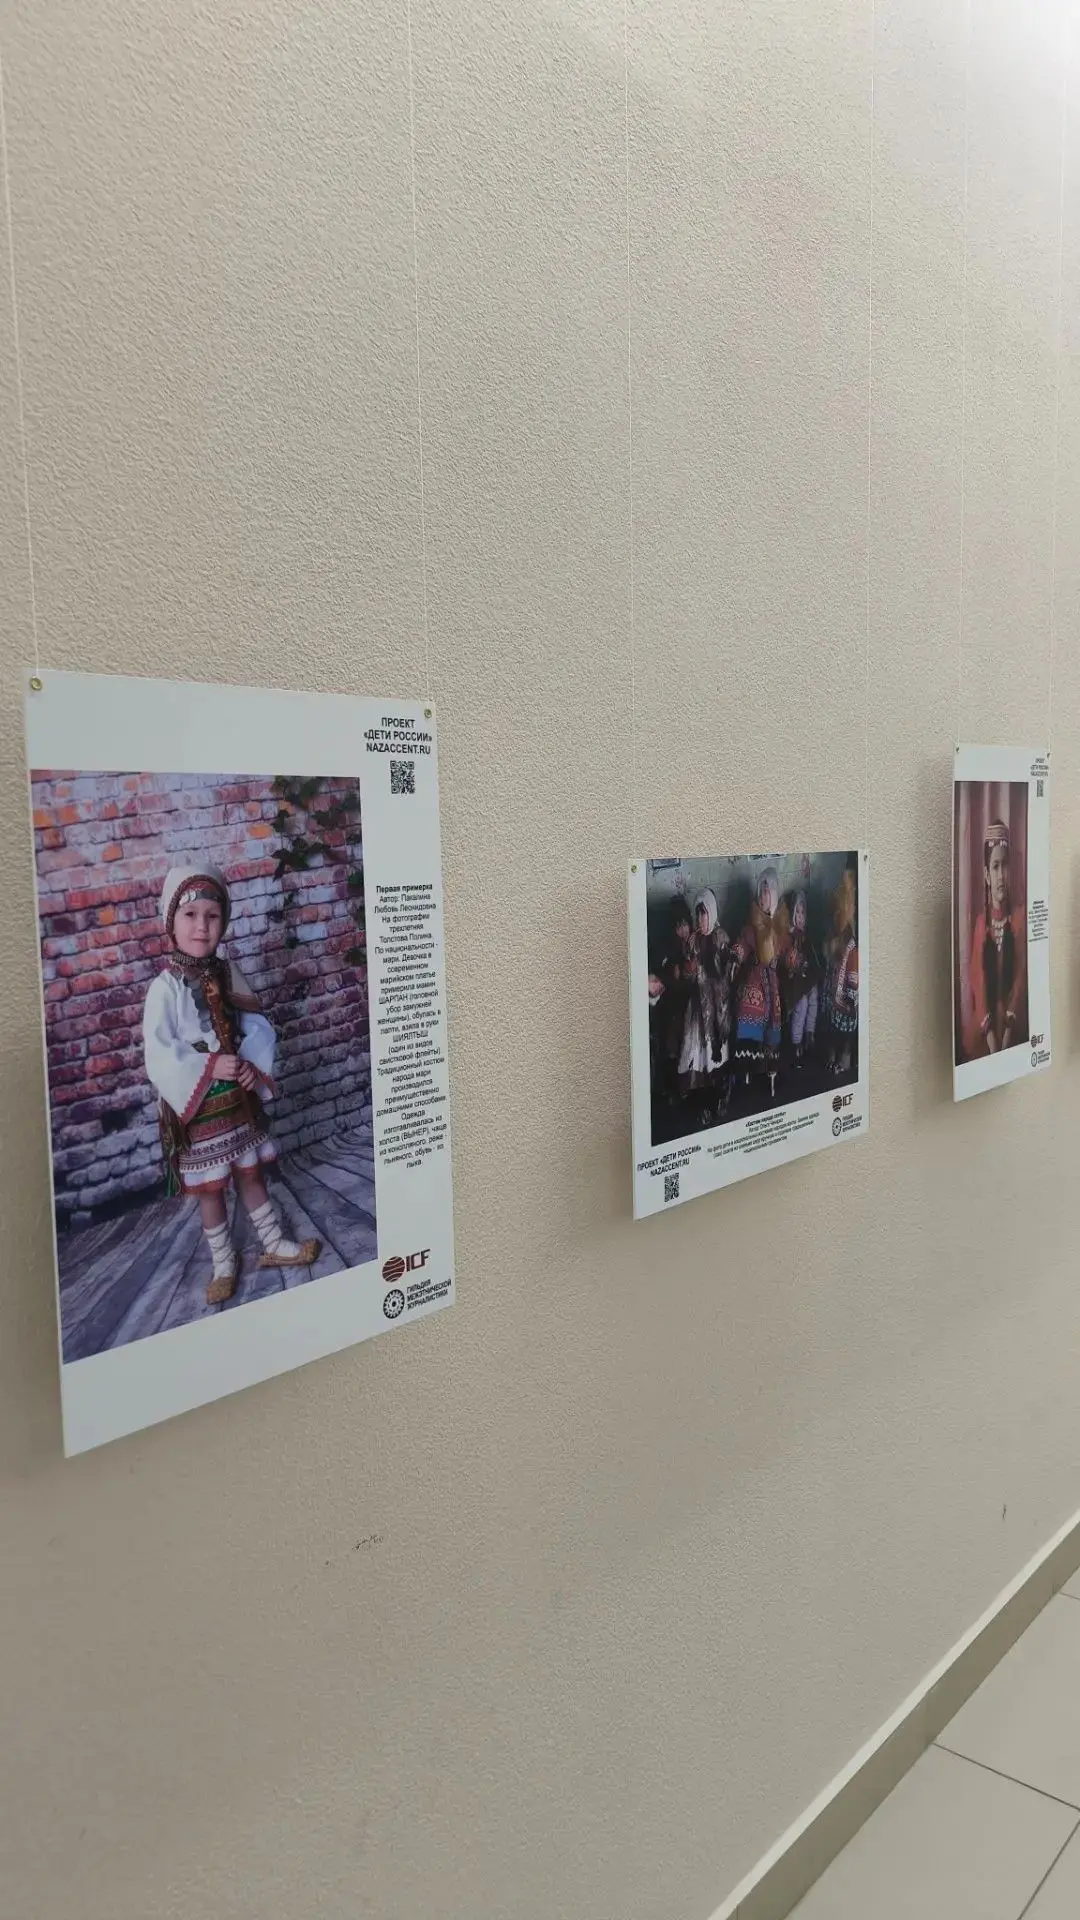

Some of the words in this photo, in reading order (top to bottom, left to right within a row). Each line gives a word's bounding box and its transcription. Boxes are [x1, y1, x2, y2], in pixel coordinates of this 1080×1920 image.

[381, 717, 415, 728] ПРОЕКТ
[363, 729, 392, 741] «ДЕТИ
[393, 731, 433, 742] РОССИИ»
[366, 743, 431, 754] NAZACCENT.RU
[376, 885, 401, 894] Первая
[402, 884, 433, 893] примерка
[374, 904, 399, 914] Любовь
[392, 913, 430, 923] фотографии
[374, 946, 384, 955] По
[385, 942, 435, 954] национальности
[402, 953, 428, 963] Девочка
[387, 963, 429, 973] современном
[380, 974, 414, 985] марийском
[415, 971, 436, 980] платье
[378, 993, 408, 1005] ШАРПАН
[386, 1004, 401, 1016] убор
[403, 1000, 432, 1011] замужней
[377, 1060, 422, 1076] Традиционный
[392, 1073, 415, 1083] народа
[391, 1078, 433, 1093] производился
[385, 1087, 440, 1105] преимущественно
[842, 1093, 854, 1107] ICF
[637, 1158, 659, 1172] ПРОЕКТ
[660, 1152, 677, 1165] «ДЕТИ
[650, 1158, 690, 1177] NAZACCENT.RU
[405, 1248, 431, 1273] ICF
